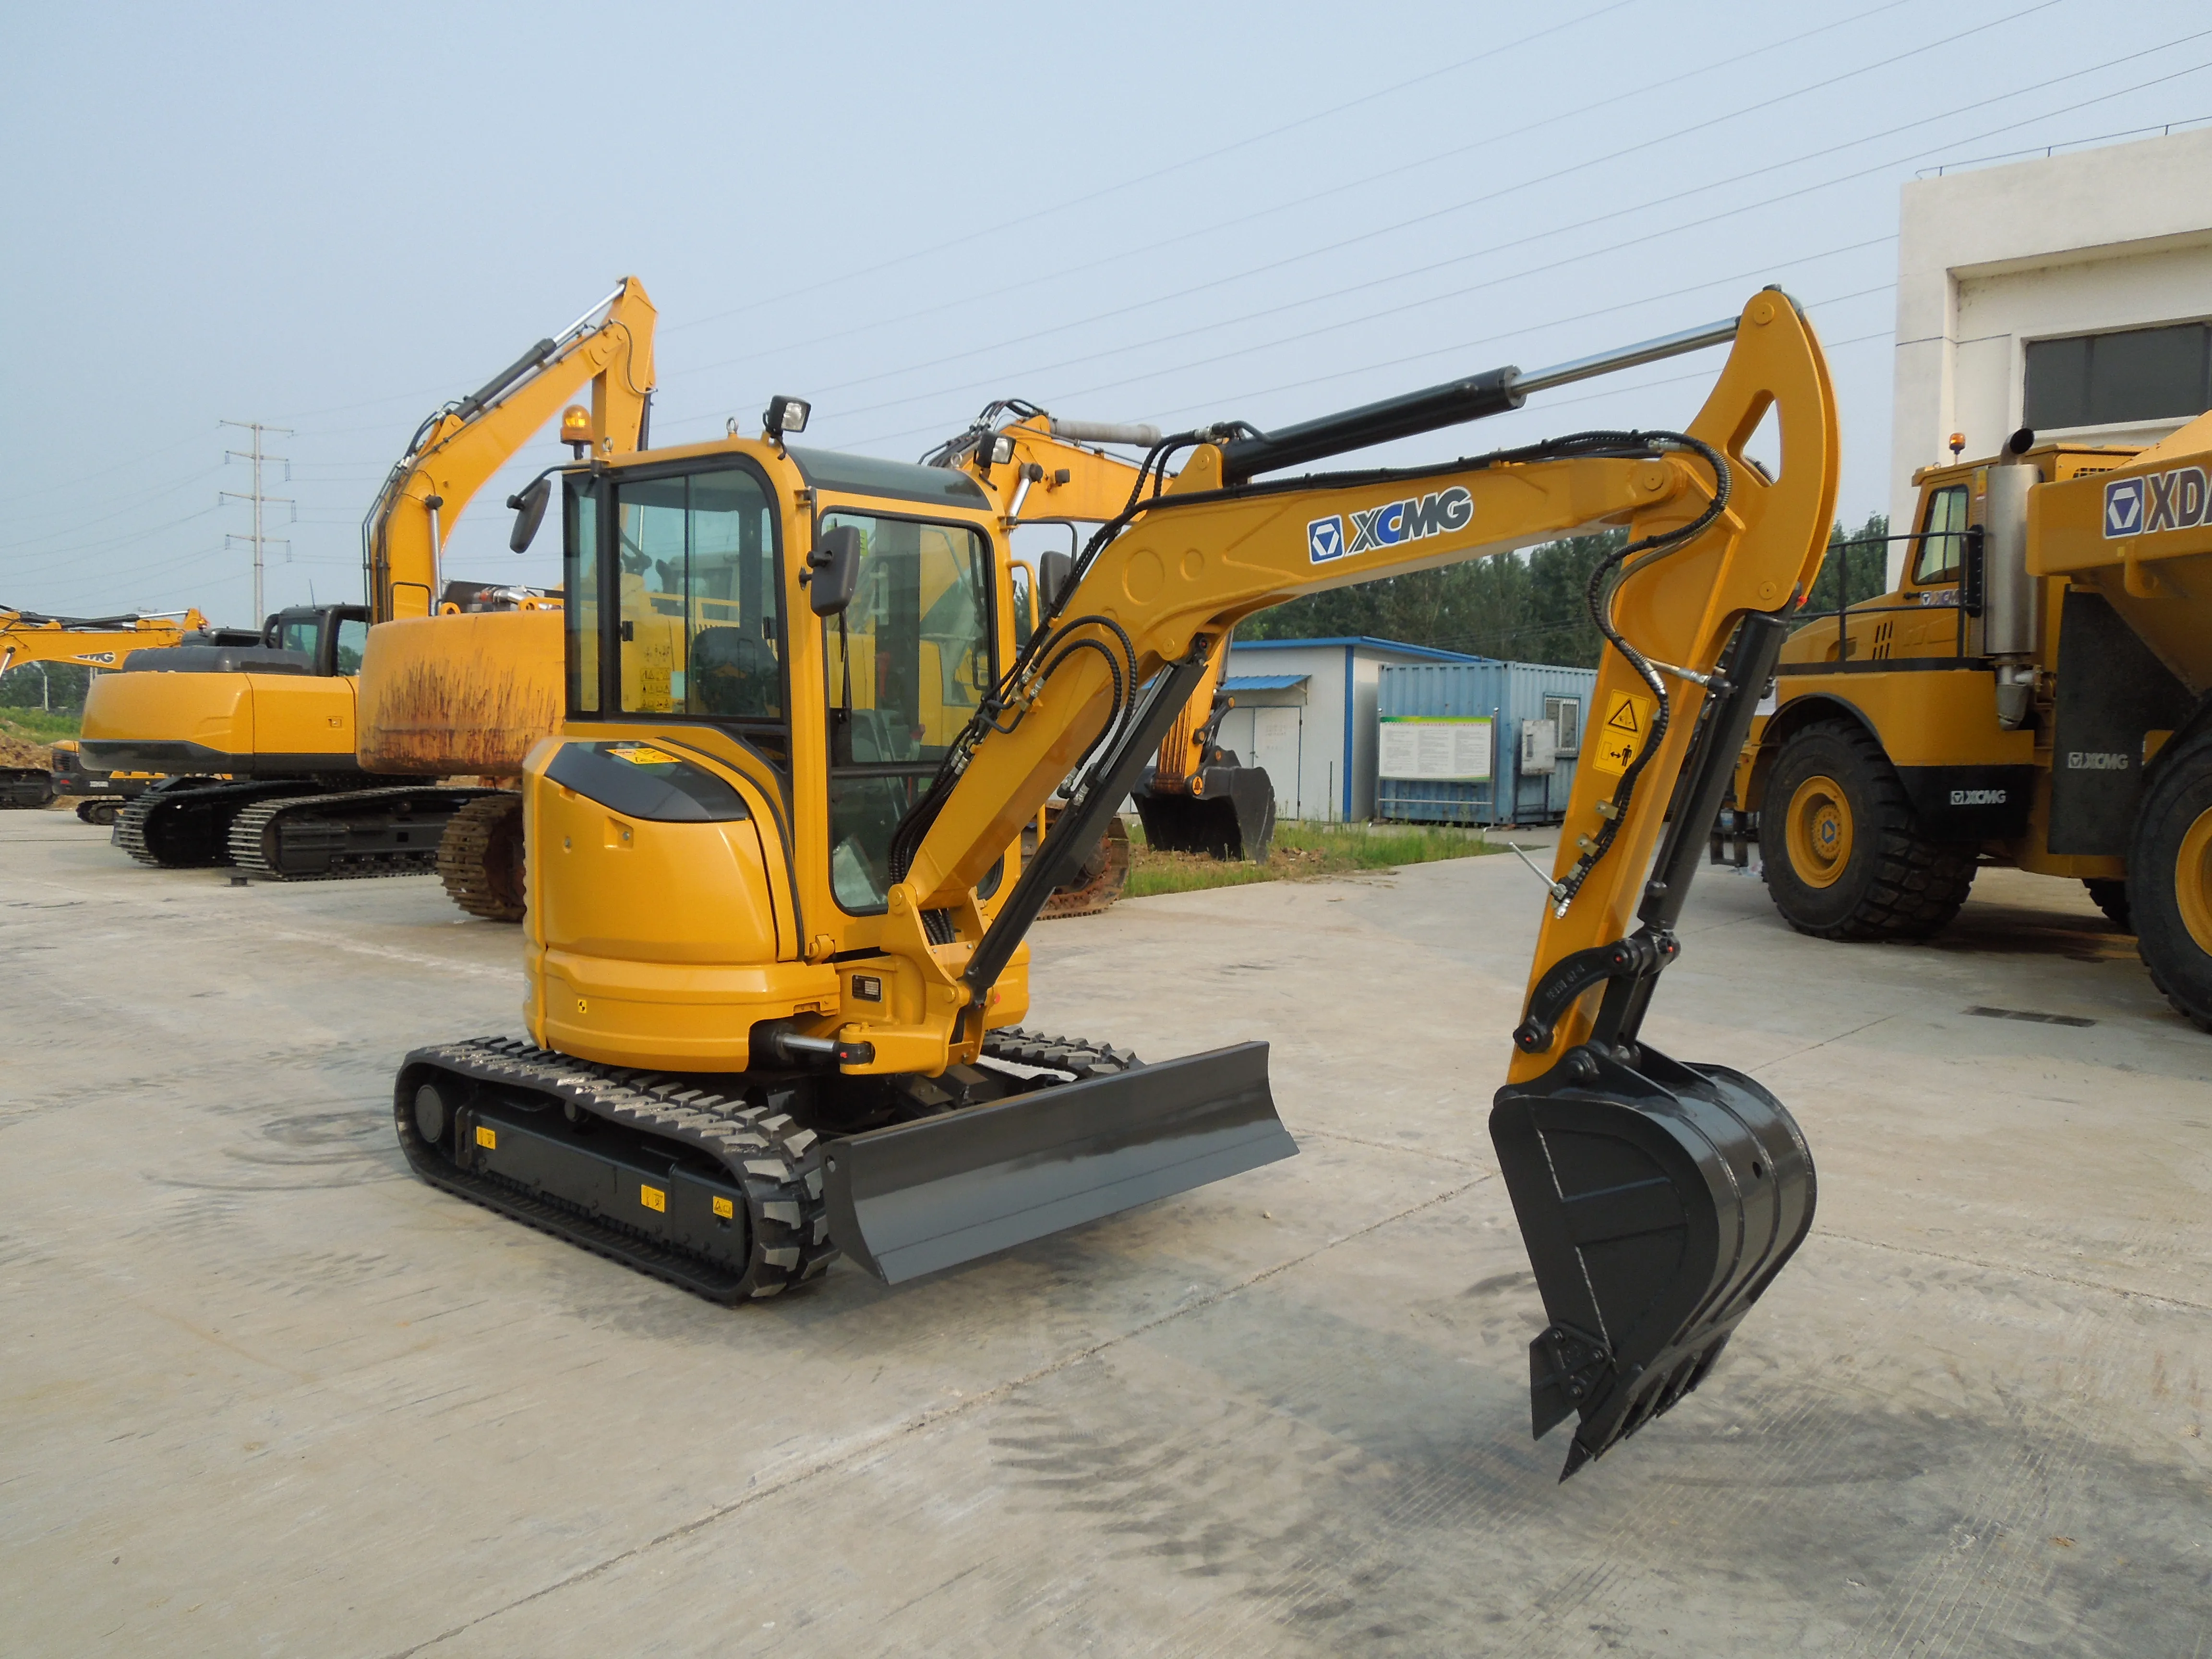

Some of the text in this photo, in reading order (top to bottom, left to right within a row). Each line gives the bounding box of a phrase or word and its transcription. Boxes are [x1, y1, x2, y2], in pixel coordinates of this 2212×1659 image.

[2144, 466, 2212, 534] XD
[1345, 486, 1474, 557] XCMG
[2082, 753, 2128, 769] XCMG
[1964, 790, 2007, 805] XCMG
